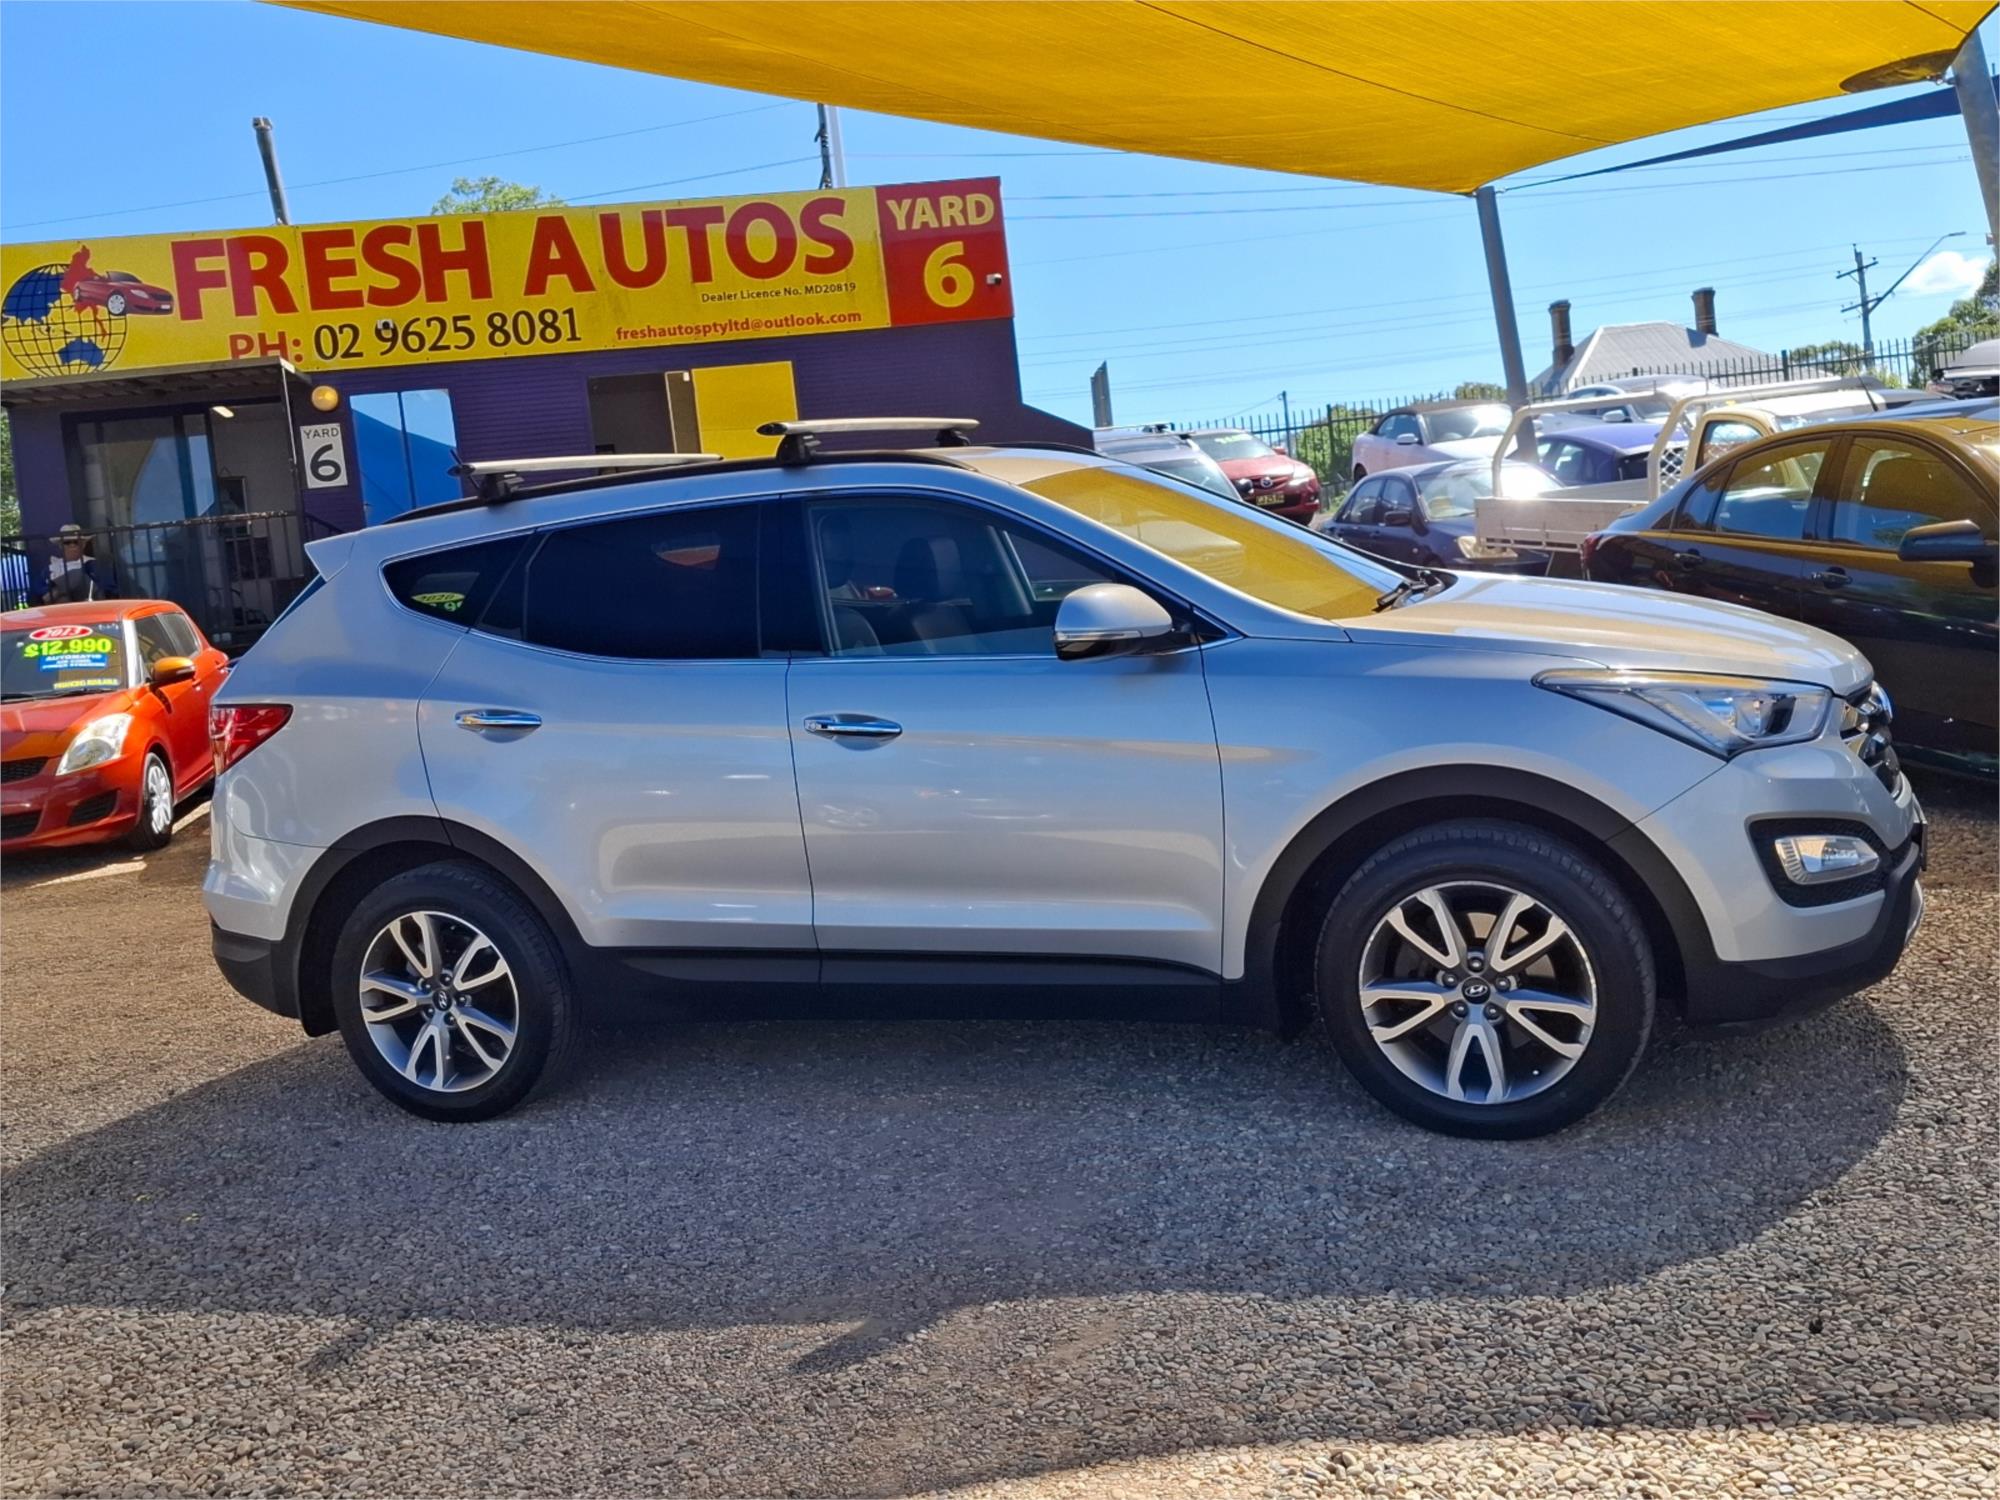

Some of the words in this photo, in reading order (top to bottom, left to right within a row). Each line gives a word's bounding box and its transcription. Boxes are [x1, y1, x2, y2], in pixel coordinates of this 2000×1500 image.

[885, 193, 995, 231] YARD
[171, 220, 493, 321] FRESH
[523, 196, 855, 297] AUTOS
[923, 240, 975, 308] 6
[702, 291, 738, 303] Dealer
[740, 288, 781, 300] Licence
[784, 286, 802, 297] No.
[804, 282, 856, 295] MD20819
[229, 330, 304, 362] PH:
[313, 323, 364, 361] 02
[374, 314, 476, 356] 9625
[486, 307, 583, 348] 8081
[616, 311, 862, 341] freshautosptyltd@outlook.com
[303, 427, 340, 440] YARD
[309, 443, 342, 483] 6
[43, 626, 83, 639] 2013
